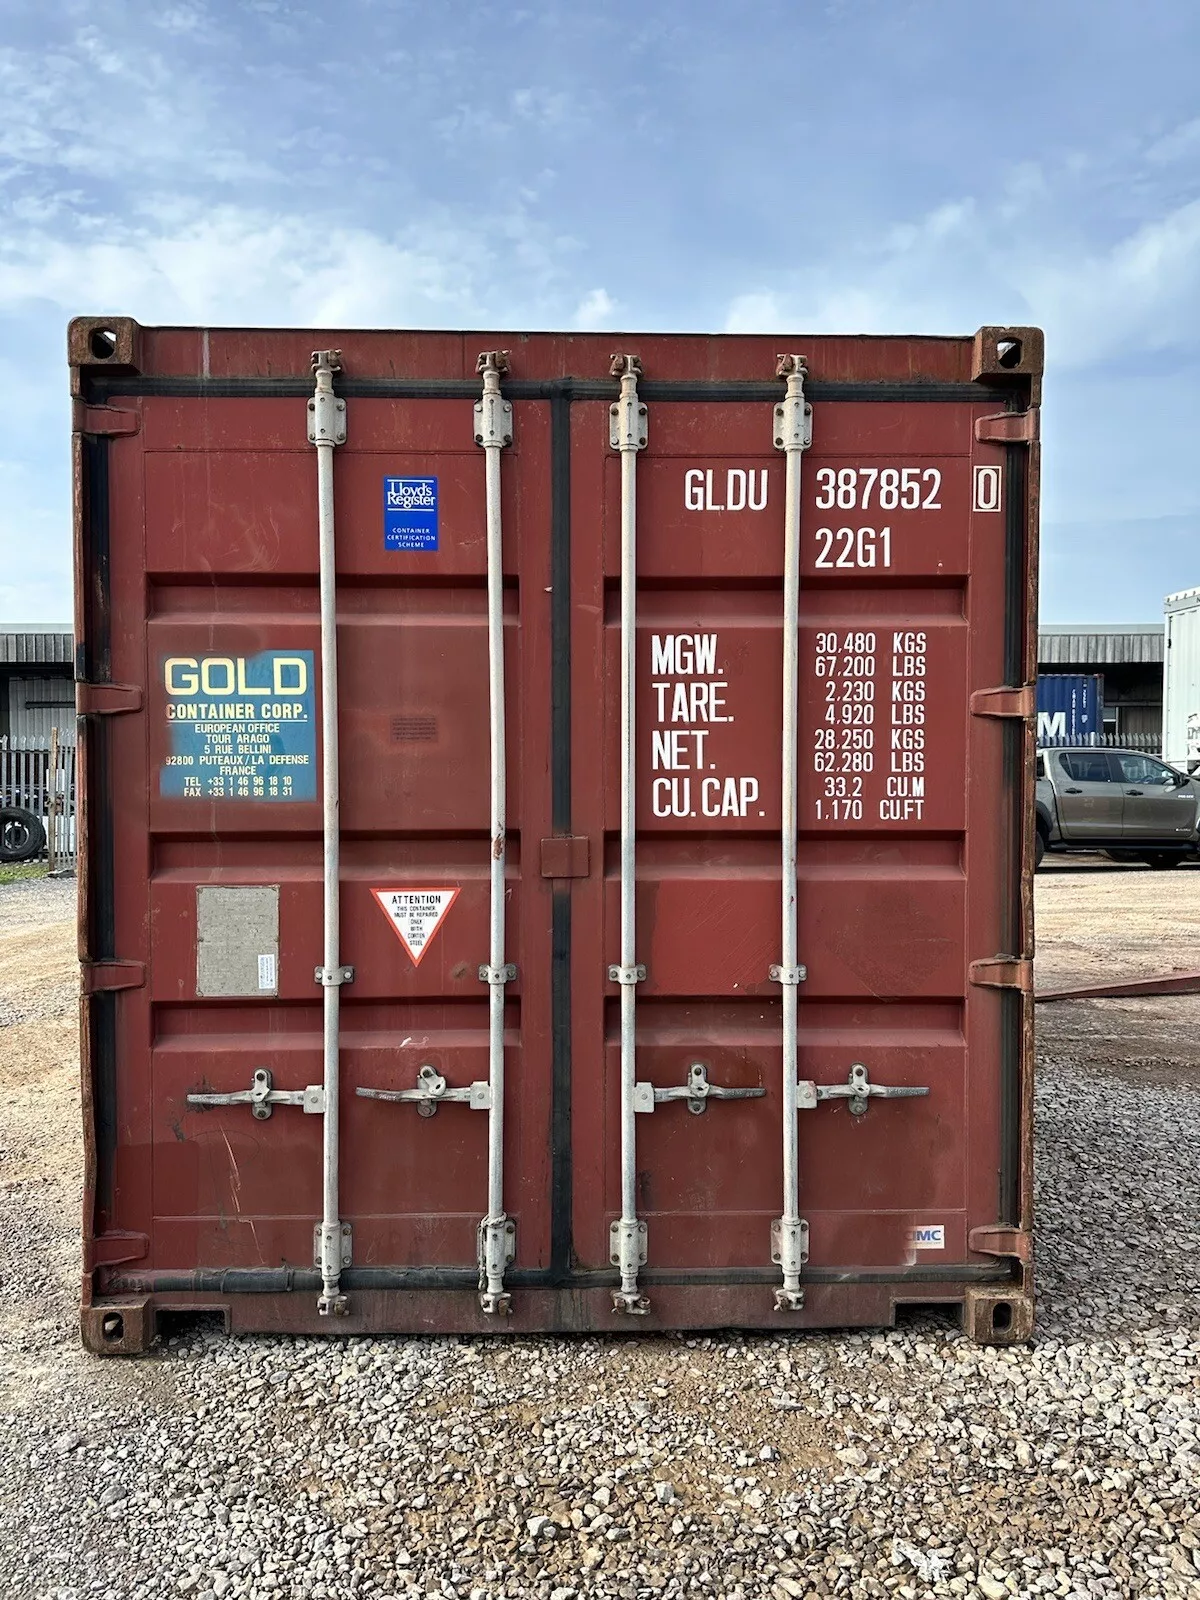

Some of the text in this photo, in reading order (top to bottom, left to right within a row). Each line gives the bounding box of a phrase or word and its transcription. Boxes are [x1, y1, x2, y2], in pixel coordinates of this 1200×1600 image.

[387, 492, 436, 508] Register
[684, 469, 768, 511] GLDU
[815, 468, 942, 510] 387852
[815, 526, 891, 569] 22G1
[815, 632, 927, 654] 30,480 KGS
[651, 633, 724, 675] MGW.
[164, 657, 307, 696] GOLD
[815, 655, 926, 677] 67,200 LBS
[825, 680, 926, 702] 2,230 KGS
[167, 703, 308, 719] CONTAINER CORP.
[651, 681, 734, 723] TARE.
[825, 703, 925, 725] 4,920 LBS
[195, 723, 280, 733] EUROPEAN OFFICE
[204, 744, 272, 754] 5 RUE BELLINI
[206, 734, 270, 744] TOUR ARAGO
[814, 728, 925, 750] 28,250 KGS
[165, 755, 194, 766] 92800
[269, 755, 309, 765] DEFENSE
[652, 730, 716, 770] NET.
[219, 765, 257, 776] FRANCE
[814, 751, 925, 773] 62,280 LBS
[184, 776, 292, 787] TEL +33 1 46 96 18 10
[184, 787, 293, 797] FAX +33 1 46 96 18 31
[824, 776, 925, 797] 33.2 CU.M
[815, 799, 925, 820] 1,170 CU.FT
[392, 895, 441, 904] ATTENTION
